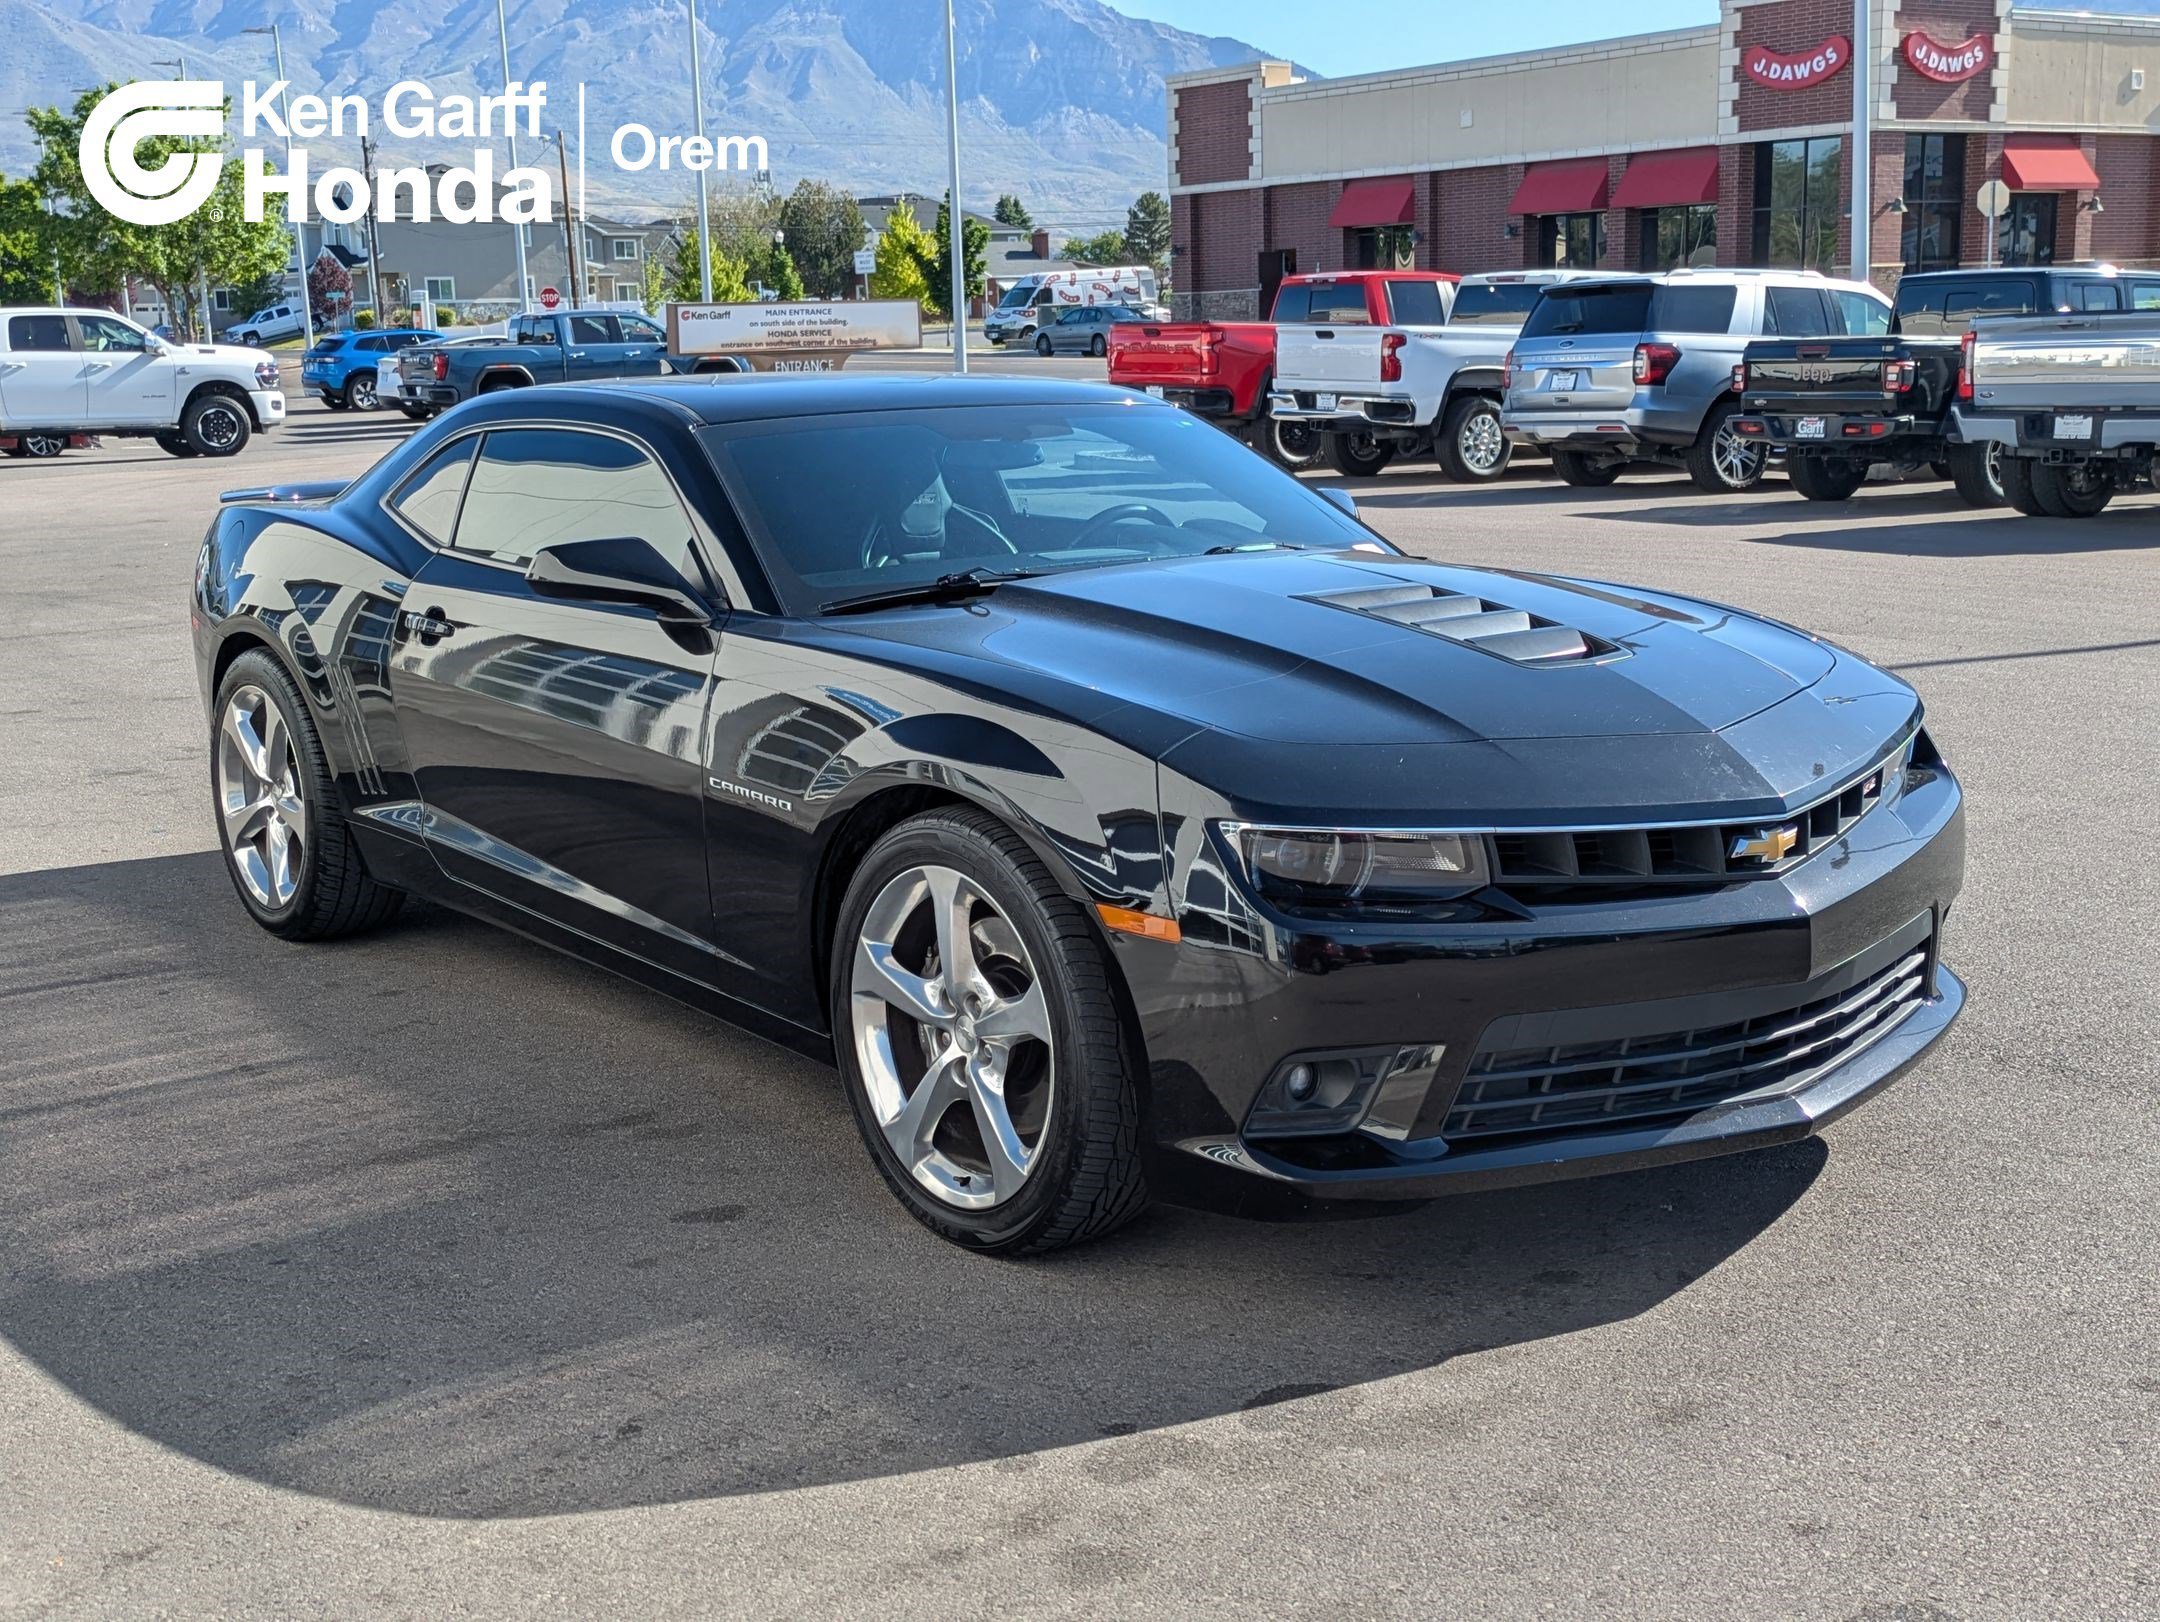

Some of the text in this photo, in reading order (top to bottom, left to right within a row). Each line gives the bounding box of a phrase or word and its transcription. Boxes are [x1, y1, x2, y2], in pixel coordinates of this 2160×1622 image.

[1753, 46, 1838, 81] J.DAWGS
[1915, 44, 1984, 73] J.DAWGS
[541, 293, 559, 303] STOP
[691, 310, 731, 320] Ken Garff
[765, 308, 832, 317] MAIN ENTRANCE
[760, 319, 780, 327] south
[806, 318, 818, 326] the
[767, 329, 832, 338] HONDA SERVICE
[765, 339, 803, 347] southwest
[828, 338, 835, 346] of
[836, 338, 848, 346] the
[1792, 363, 1830, 384] Jeep
[1797, 420, 1825, 434] Garff
[709, 776, 793, 812] CAMARO
